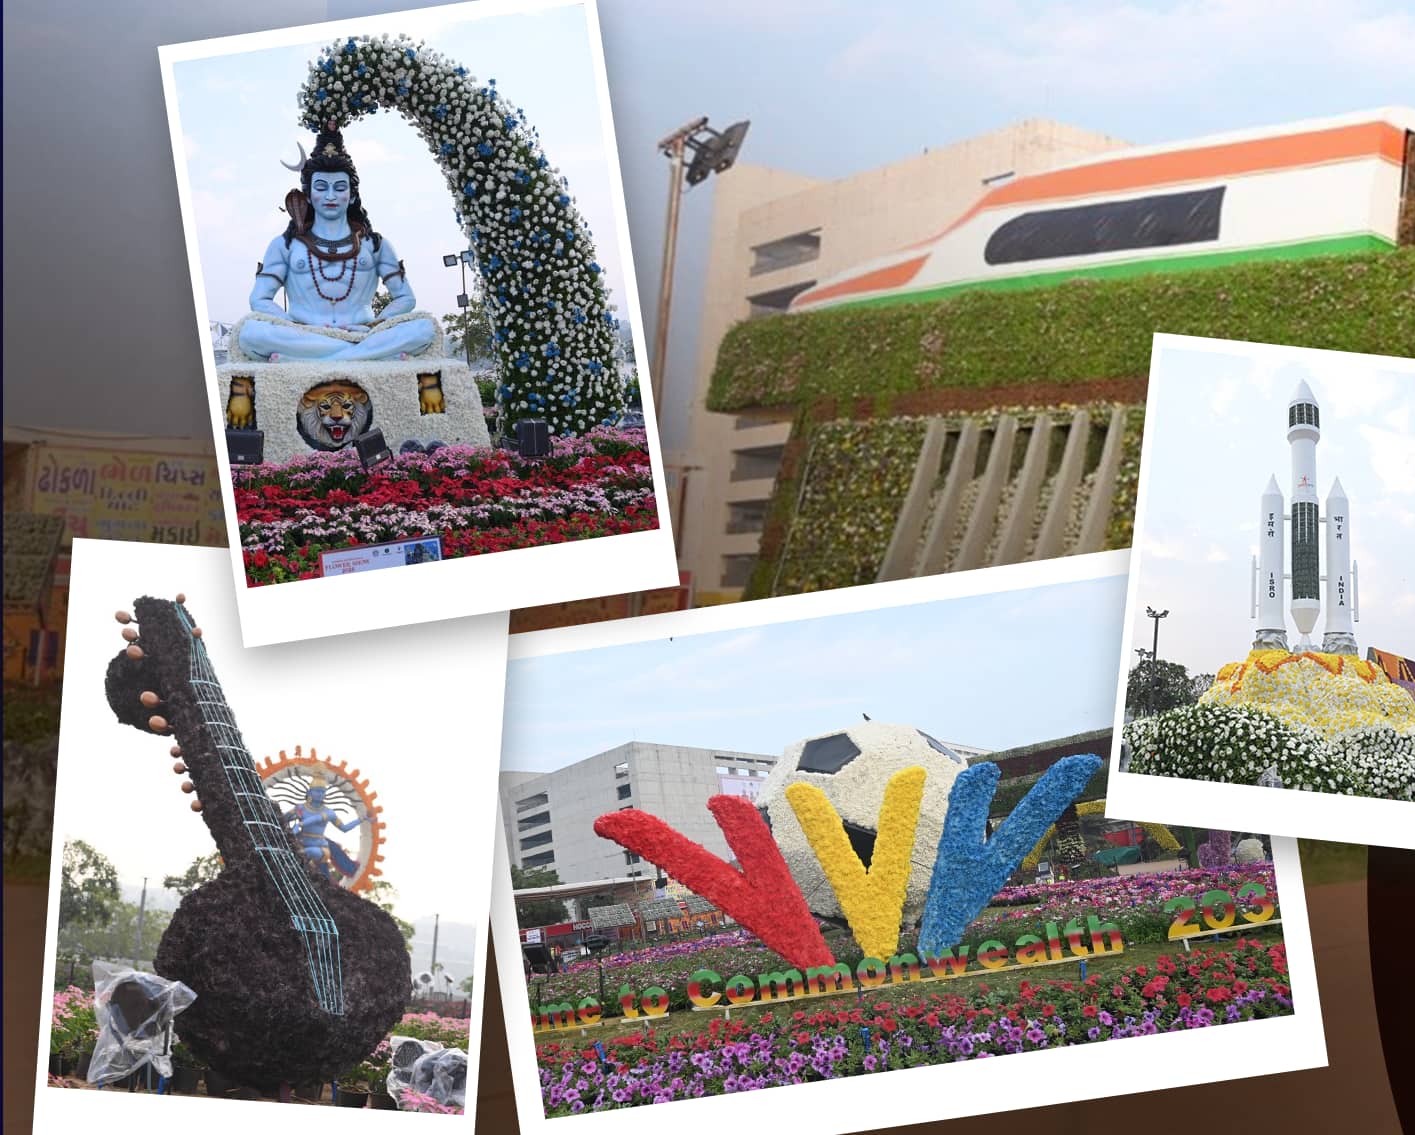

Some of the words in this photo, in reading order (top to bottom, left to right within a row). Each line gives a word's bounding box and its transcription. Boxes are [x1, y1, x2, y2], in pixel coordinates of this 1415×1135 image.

[531, 996, 602, 1031] me
[618, 983, 670, 1018] to
[687, 915, 1123, 1007] Commonwealth
